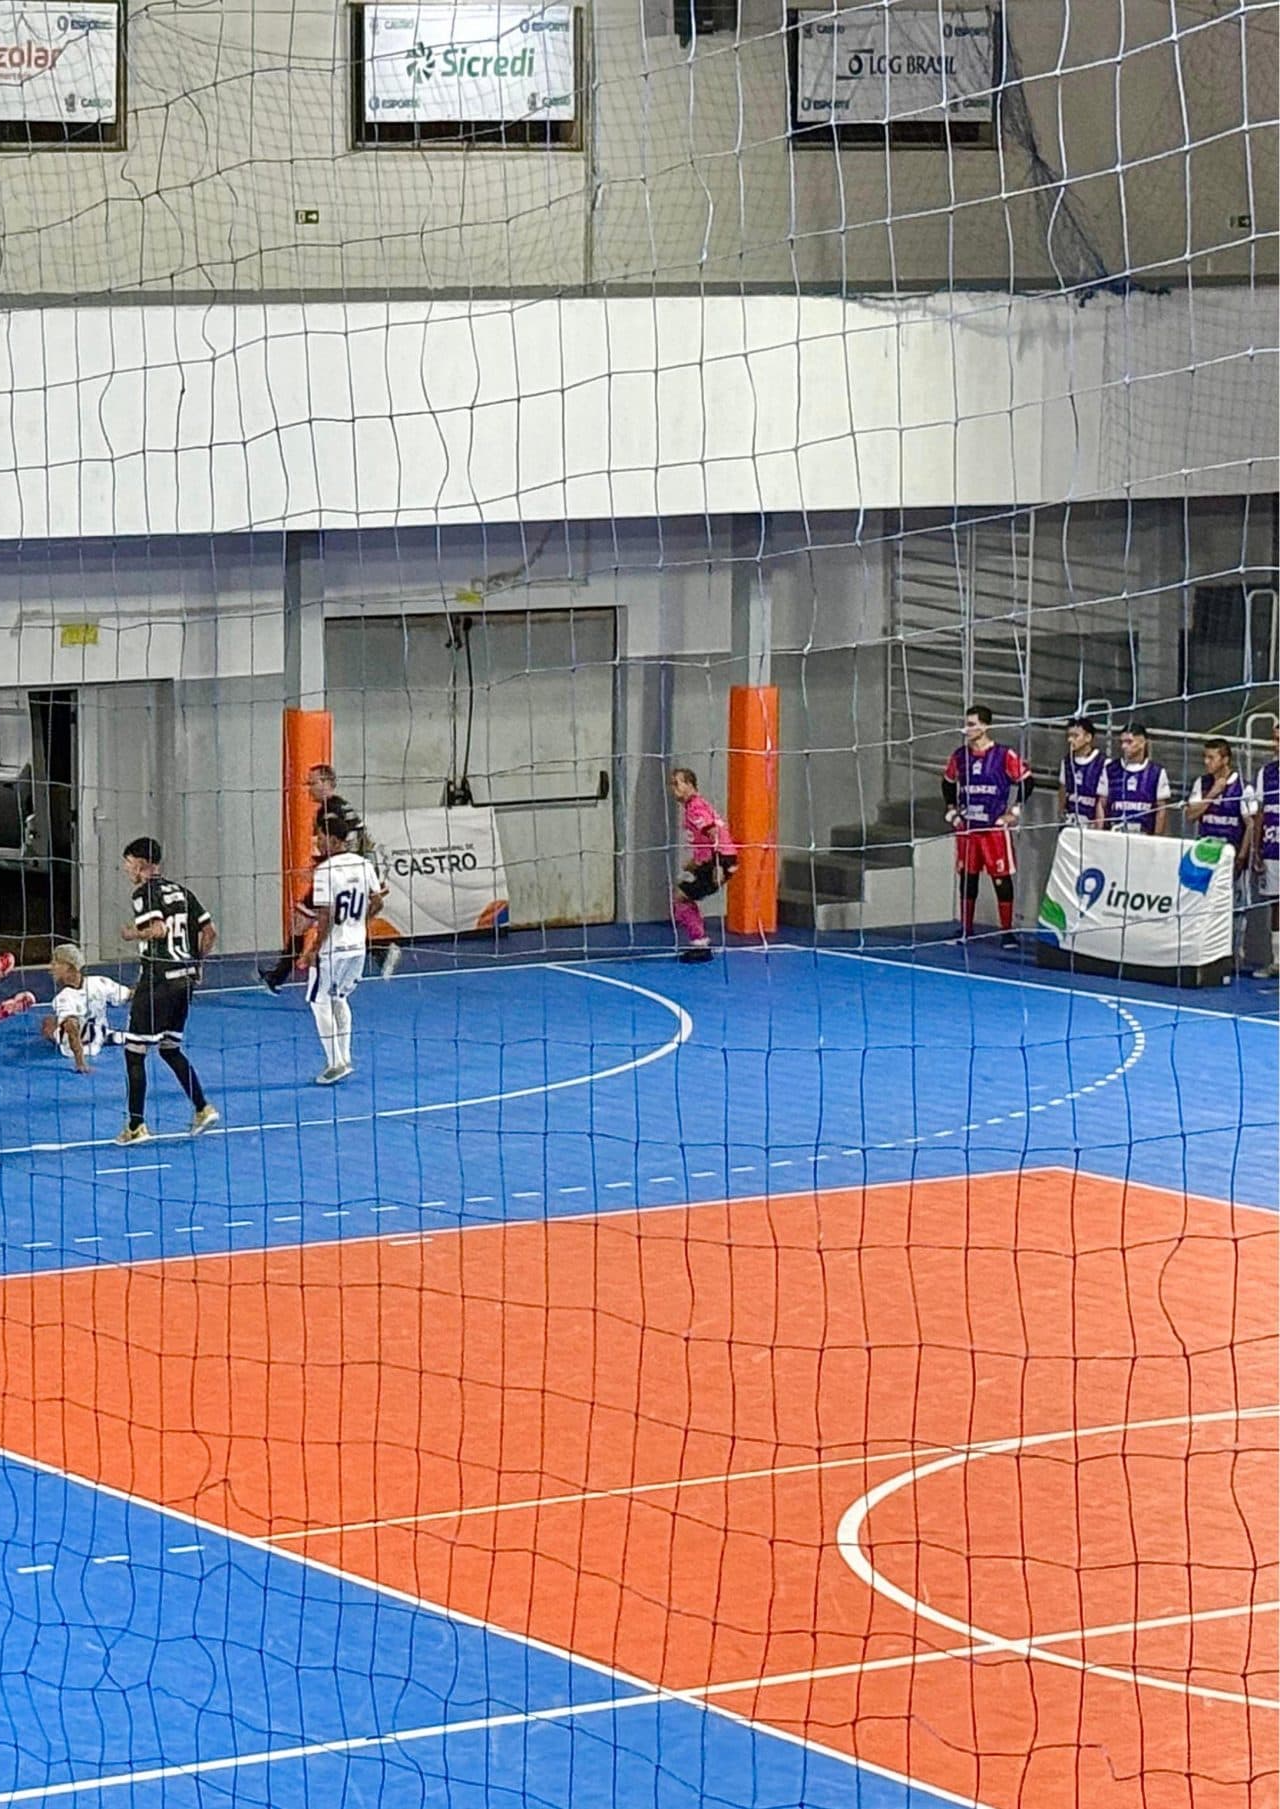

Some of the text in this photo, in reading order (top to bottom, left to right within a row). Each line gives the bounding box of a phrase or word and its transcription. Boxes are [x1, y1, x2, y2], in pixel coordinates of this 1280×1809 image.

[441, 48, 535, 77] Sicredi
[394, 852, 478, 877] CASTRO
[1106, 881, 1173, 914] inove
[165, 912, 192, 961] 15
